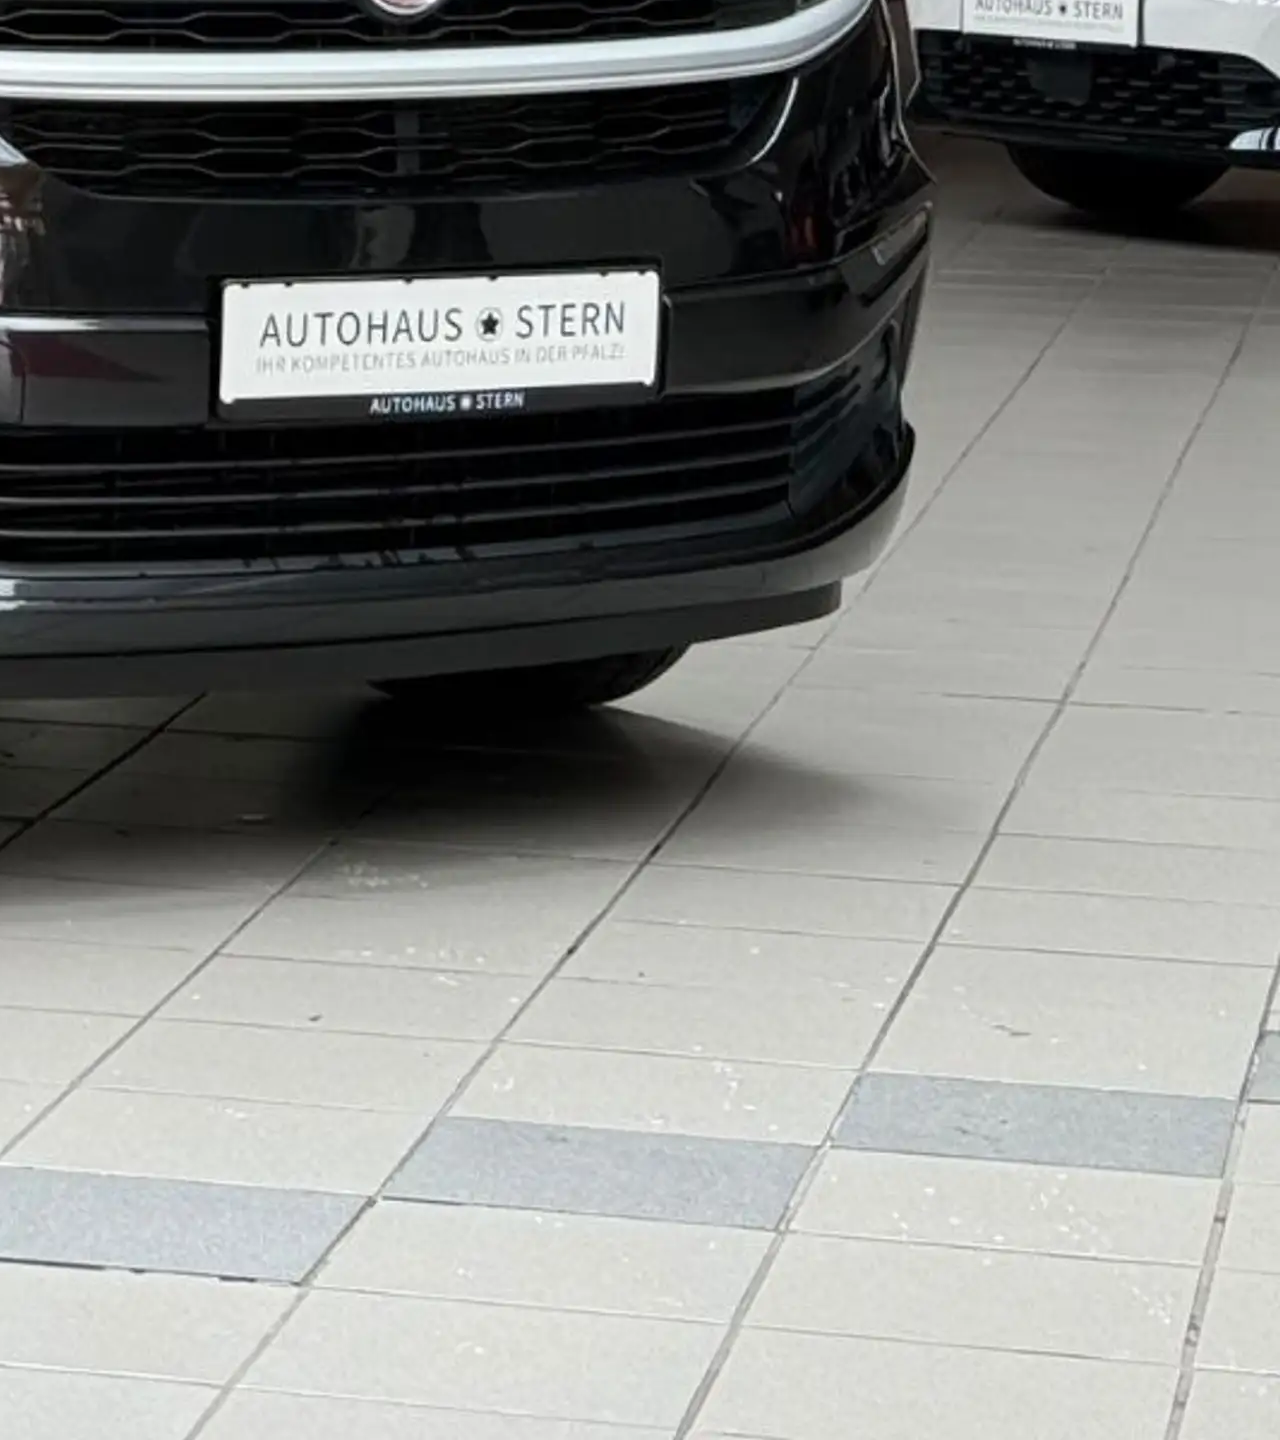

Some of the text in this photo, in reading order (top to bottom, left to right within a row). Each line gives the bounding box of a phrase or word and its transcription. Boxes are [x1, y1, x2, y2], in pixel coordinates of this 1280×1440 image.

[1073, 0, 1124, 21] STERN
[259, 300, 625, 348] AUTOHAUS STERN
[256, 355, 286, 375] IHR
[290, 350, 416, 373] KOMPETENTES
[421, 347, 511, 368] AUTOHAUS
[515, 347, 531, 365] IN
[536, 345, 568, 364] DER
[369, 391, 526, 415] AUTOHAUS STERN
